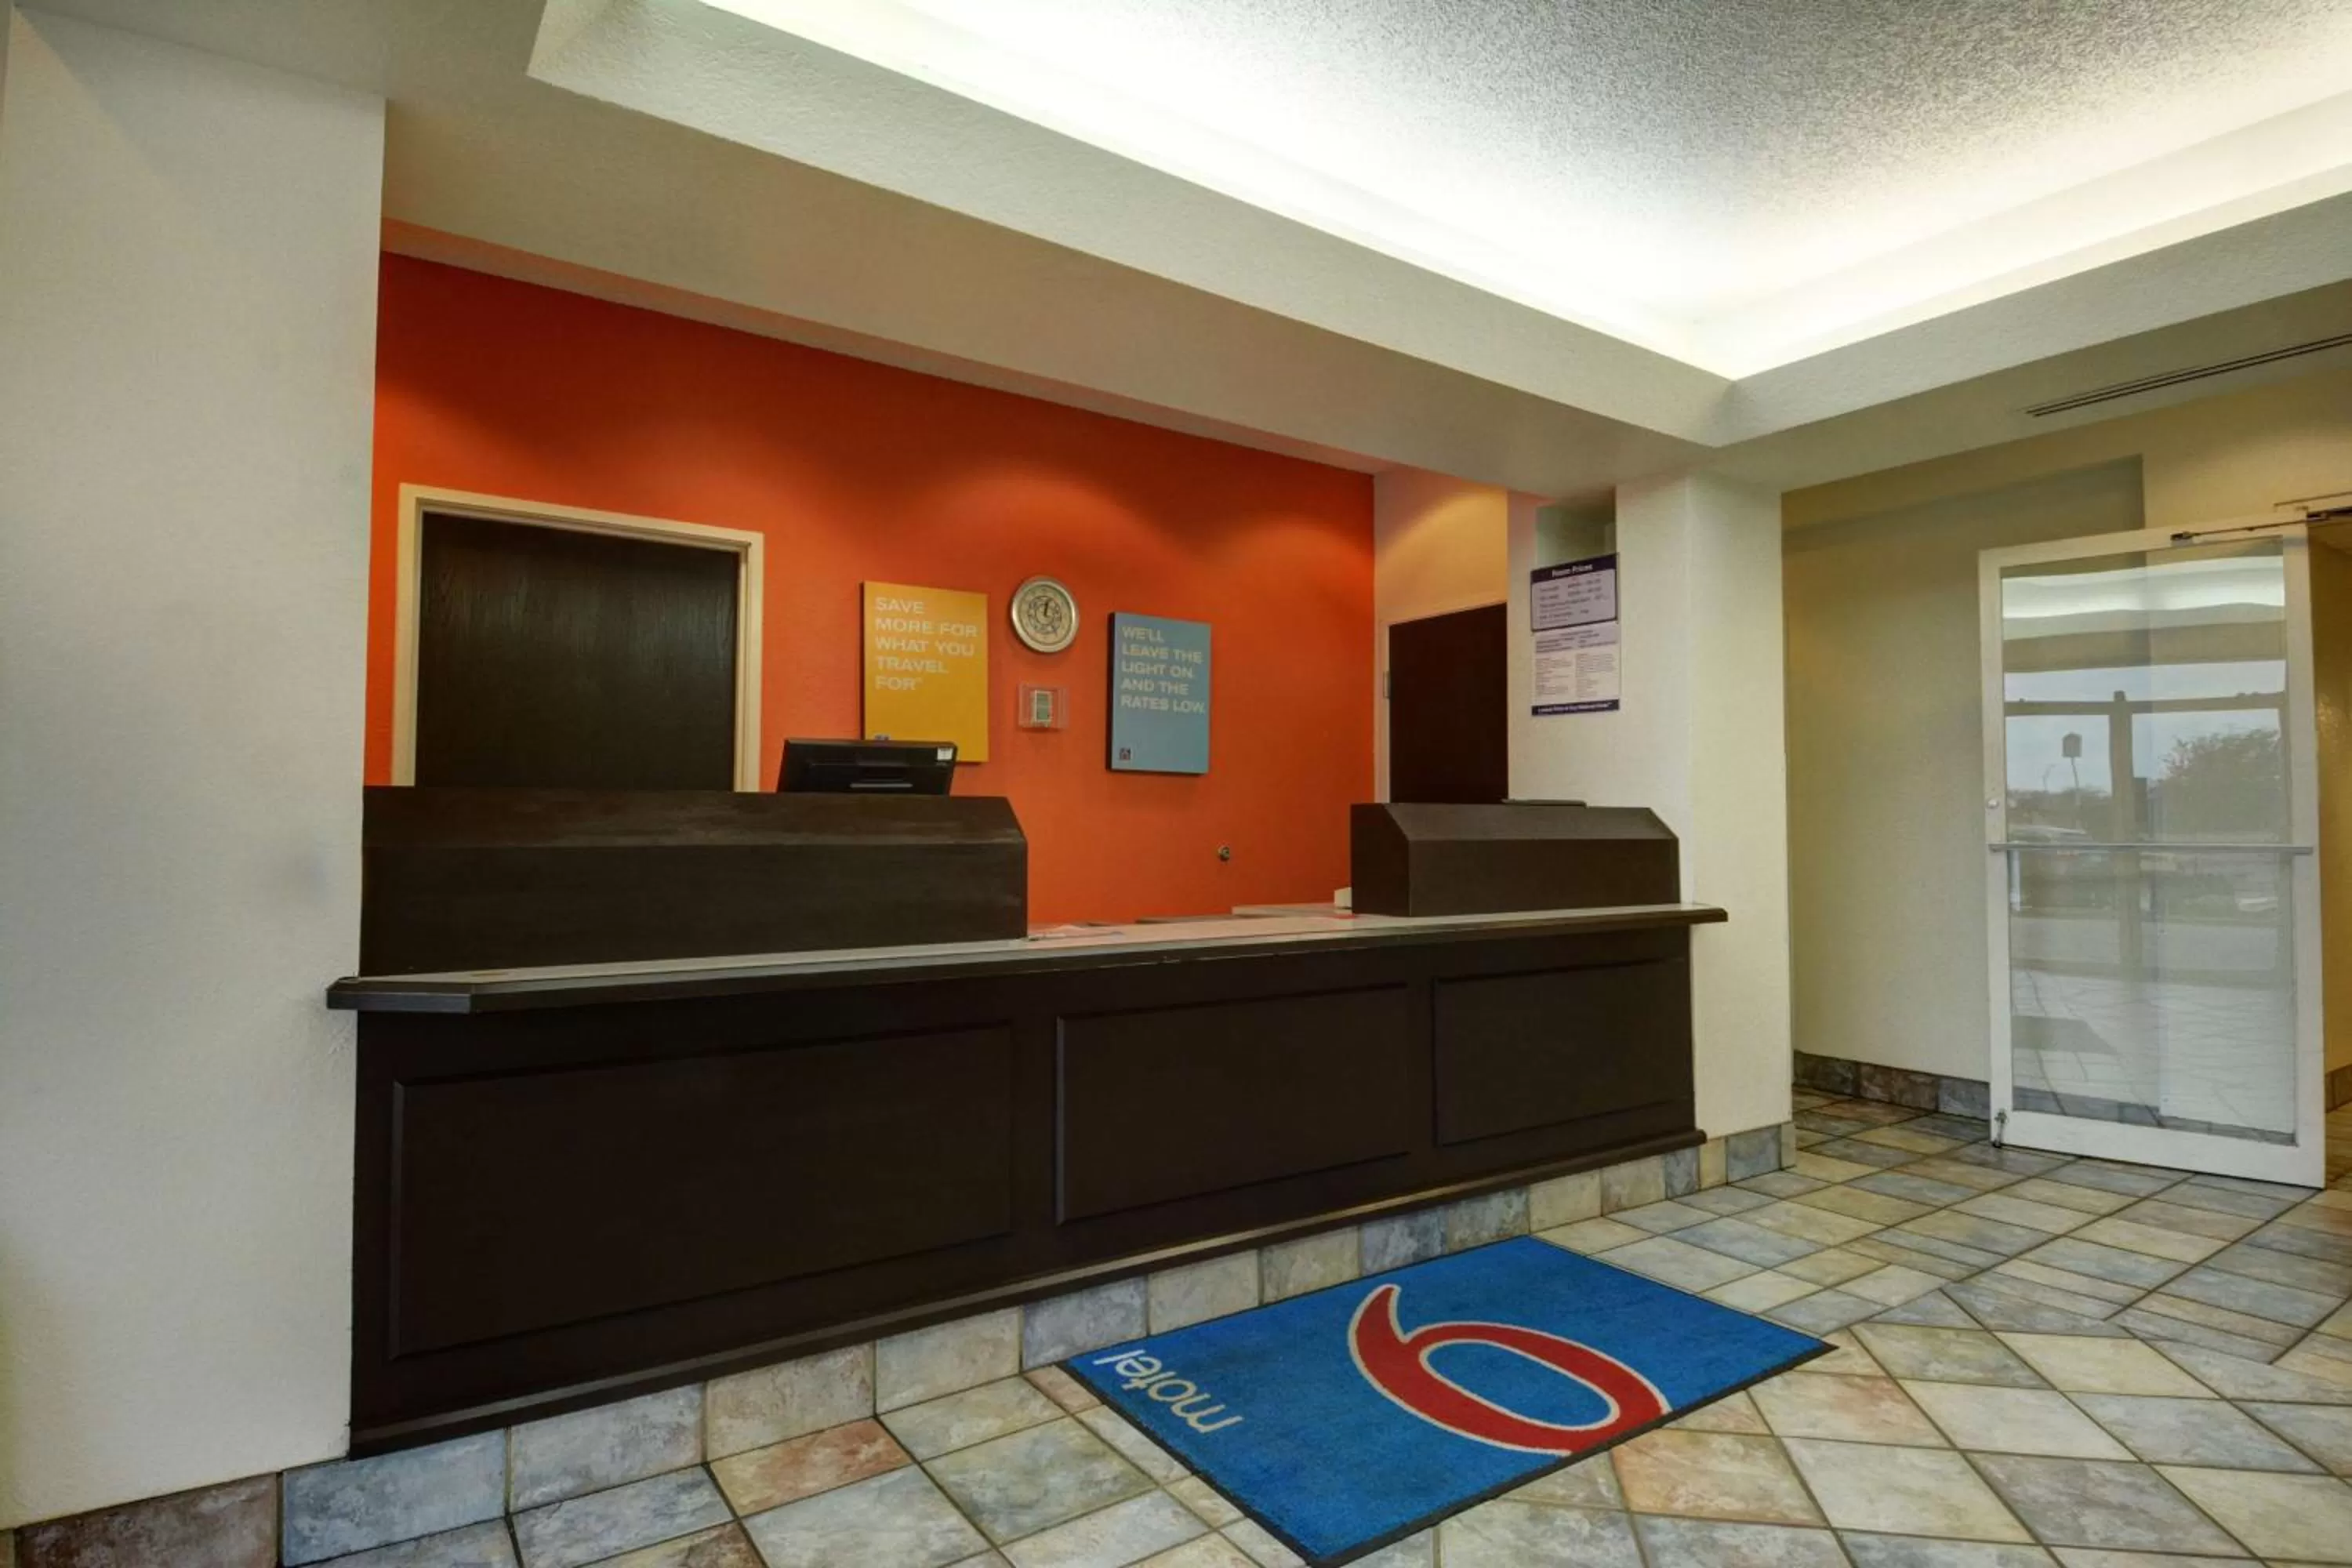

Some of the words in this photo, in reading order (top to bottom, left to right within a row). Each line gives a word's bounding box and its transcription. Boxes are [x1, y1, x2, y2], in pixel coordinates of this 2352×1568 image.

[876, 597, 924, 615] SAVE
[876, 618, 935, 634] MORE
[940, 622, 978, 637] FOR
[876, 637, 929, 653] WHAT
[935, 640, 975, 656] YOU
[1121, 644, 1169, 659] LEAVE
[1173, 649, 1203, 664] THE
[876, 655, 949, 674] TRAVEL
[1121, 661, 1167, 676] LIGHT
[1120, 677, 1155, 691] AND
[1160, 681, 1189, 695] THE
[1120, 695, 1170, 711] RATES
[1347, 1283, 1674, 1457] 6
[1092, 1348, 1245, 1434] motel
